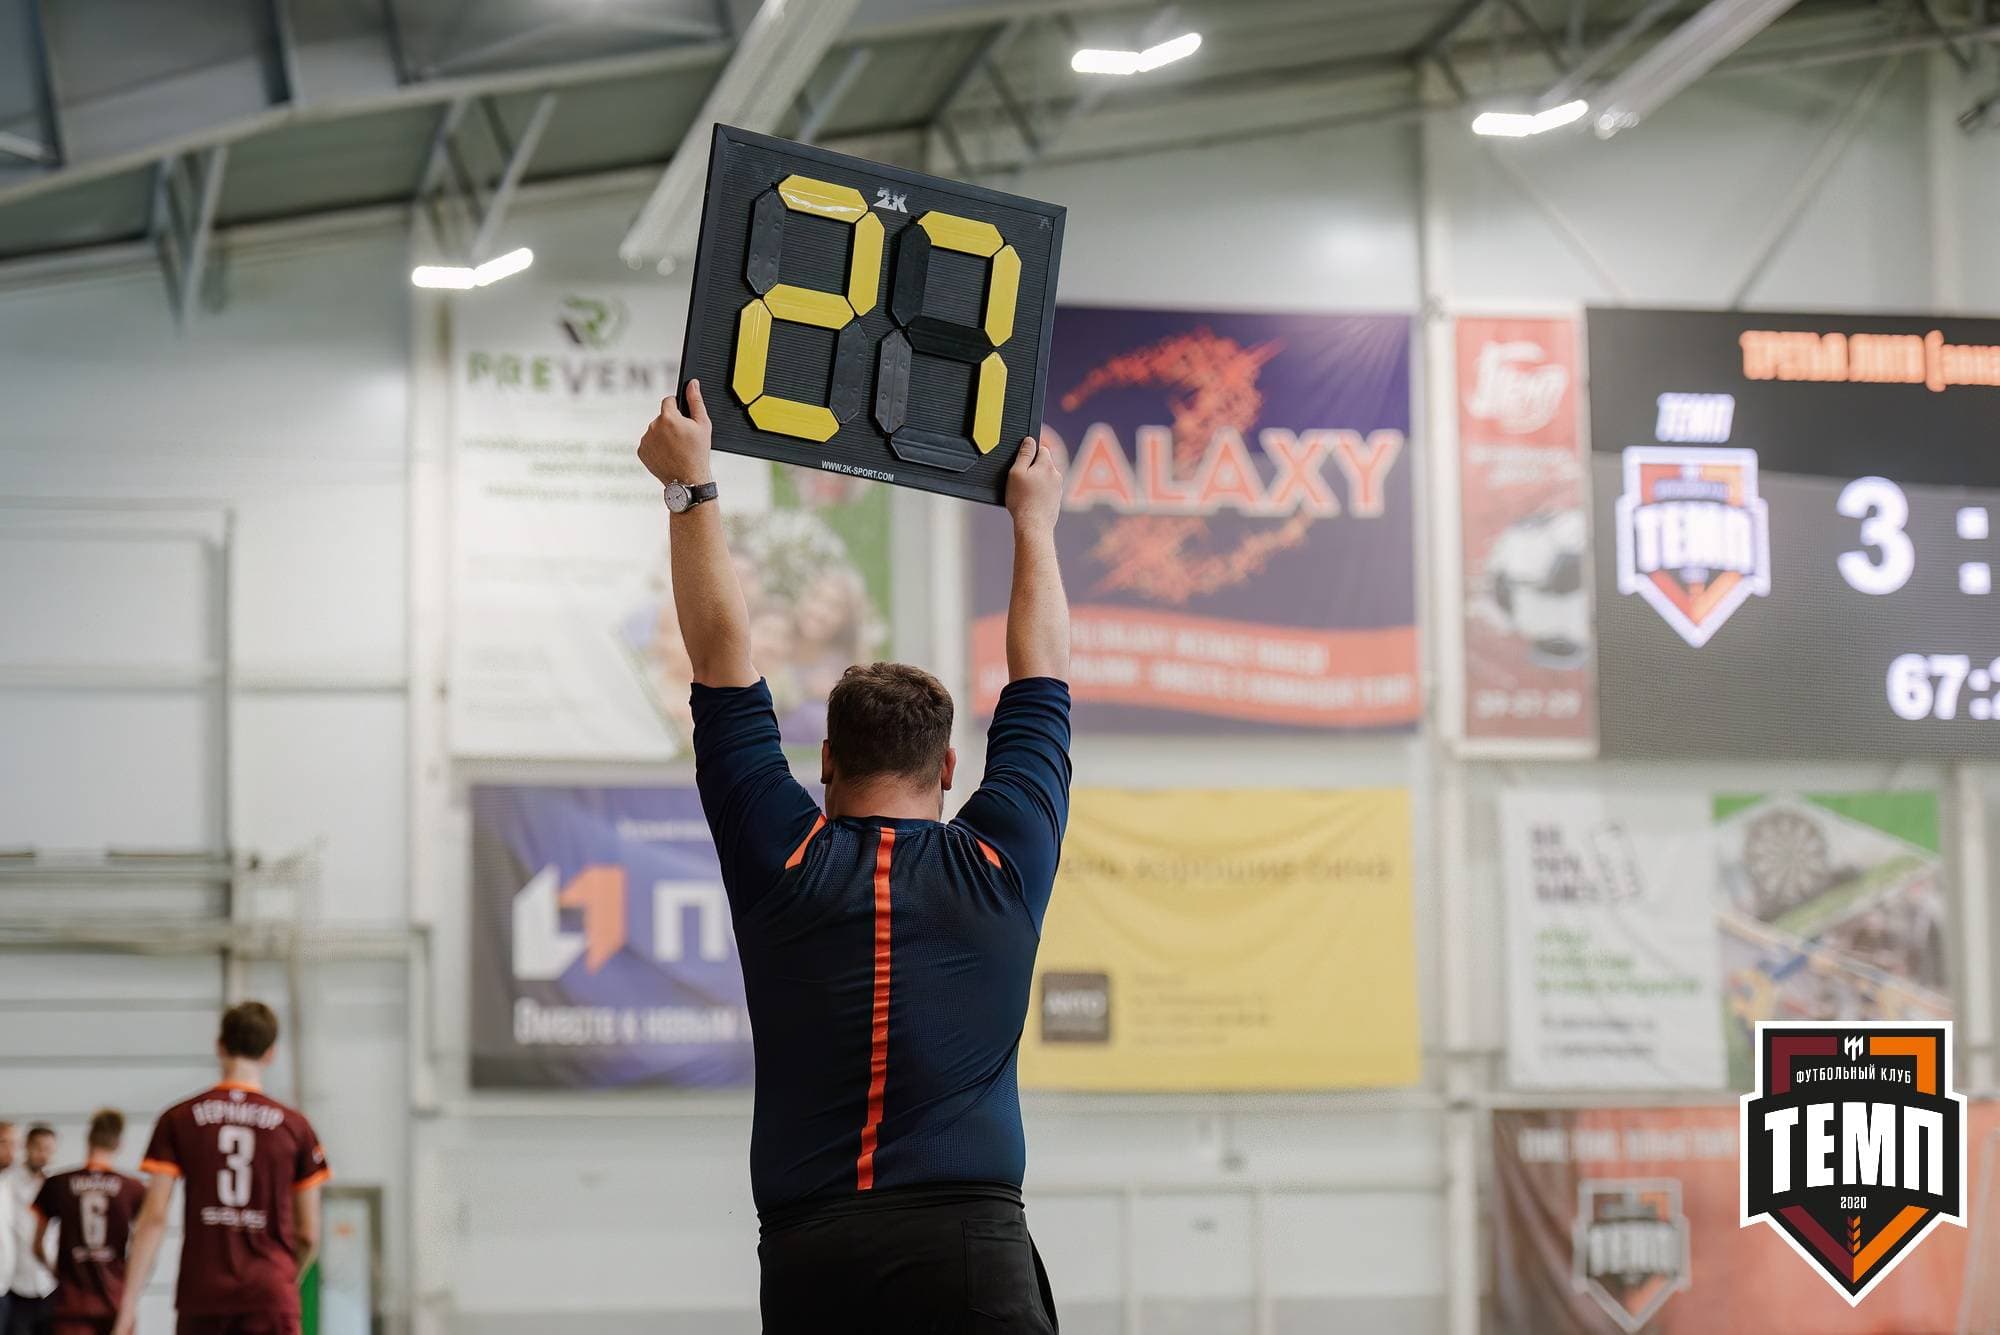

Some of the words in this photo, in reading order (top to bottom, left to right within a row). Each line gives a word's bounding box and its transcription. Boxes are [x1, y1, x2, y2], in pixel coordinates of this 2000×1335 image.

[873, 187, 908, 213] 2K
[731, 174, 1022, 456] 27
[821, 460, 895, 482] WWW.2K-SPORT.COM
[1837, 476, 1915, 595] 3
[217, 1125, 256, 1207] 3
[81, 1192, 109, 1250] 6
